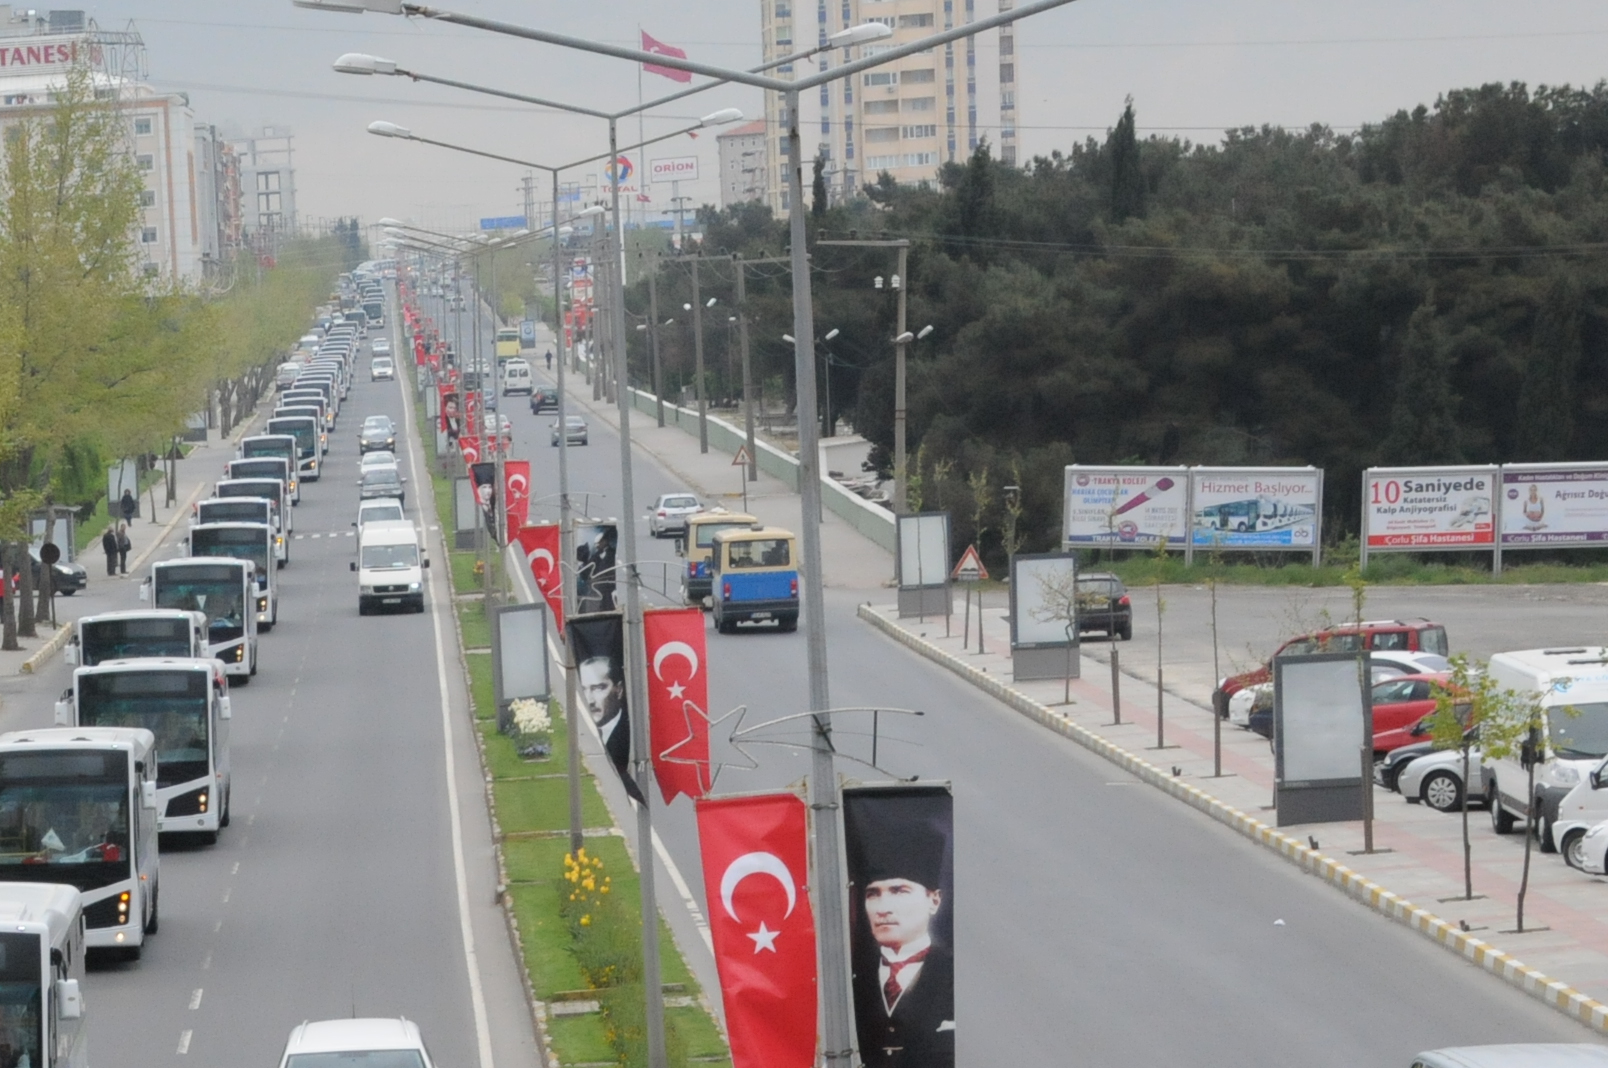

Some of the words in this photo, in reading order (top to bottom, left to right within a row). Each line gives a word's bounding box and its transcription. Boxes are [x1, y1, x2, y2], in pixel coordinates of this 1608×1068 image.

[1201, 482, 1249, 493] Hizmet
[1371, 480, 1401, 504] 10
[1403, 477, 1485, 495] Saniyede
[1403, 496, 1447, 504] Katatersiz
[1376, 505, 1397, 515] Kalp
[1398, 503, 1457, 515] Anjiyografisi
[1384, 534, 1409, 546] Çorlu
[1411, 532, 1428, 545] Şifa
[1429, 530, 1475, 543] Hastanesi
[1547, 532, 1588, 542] Hastanesi
